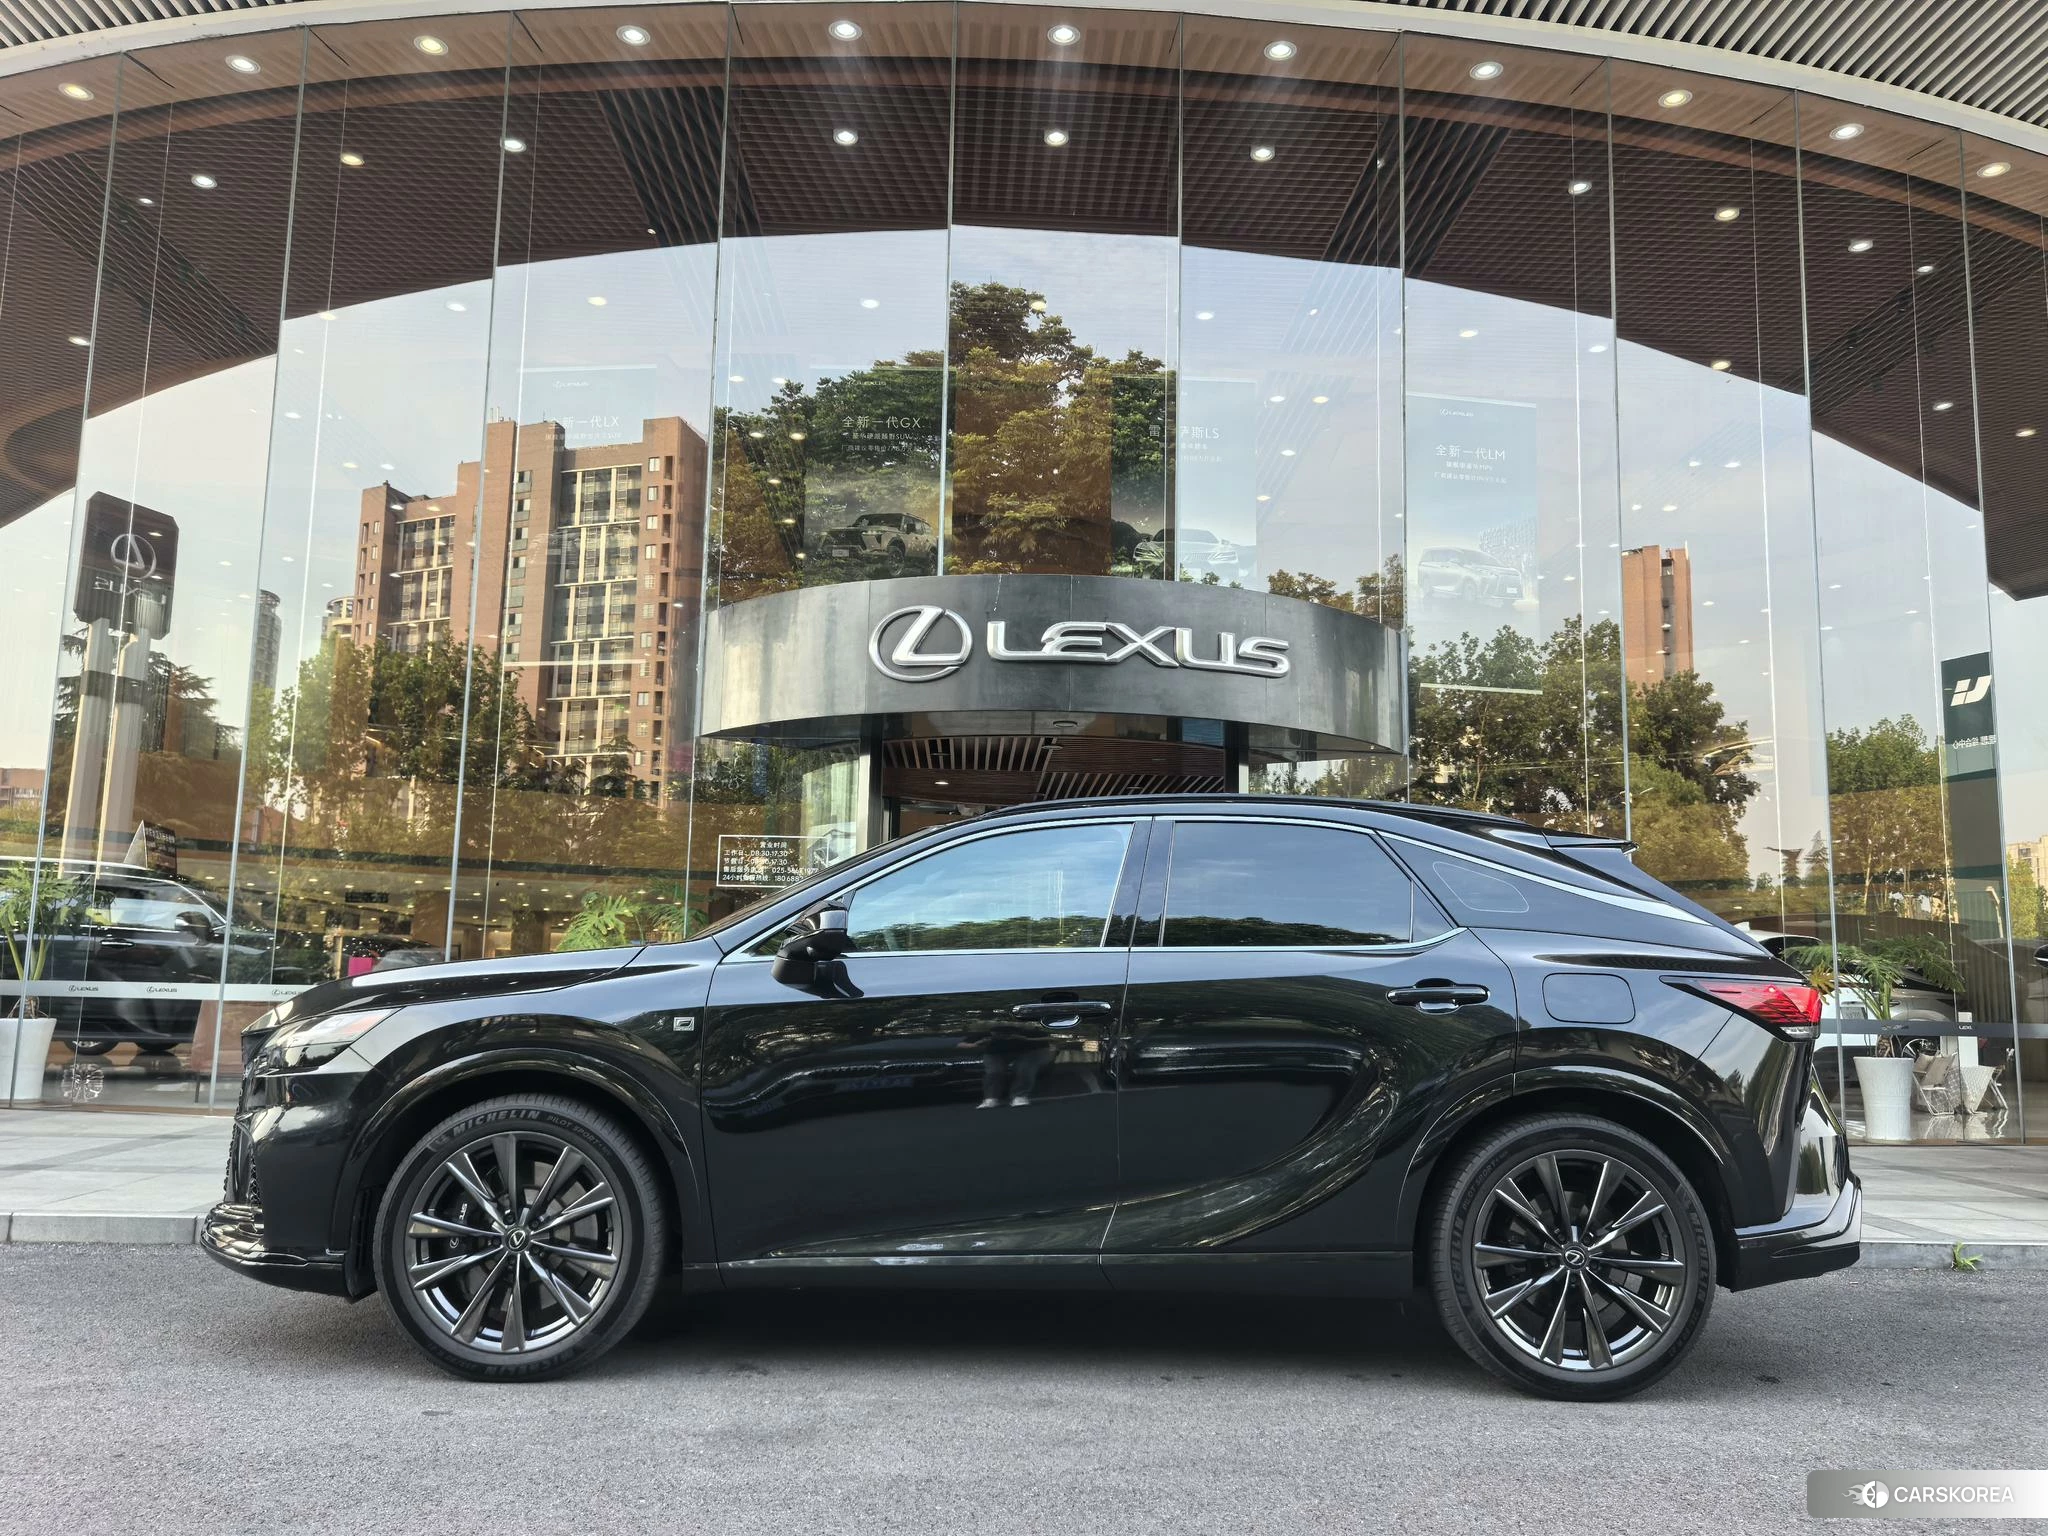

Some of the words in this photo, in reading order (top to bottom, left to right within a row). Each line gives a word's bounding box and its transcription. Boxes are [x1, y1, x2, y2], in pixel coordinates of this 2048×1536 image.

[842, 415, 921, 429] 全新一代GX
[1436, 444, 1505, 460] 全新一代LM
[986, 620, 1290, 679] LEXUS
[453, 1109, 541, 1137] MICHELIN
